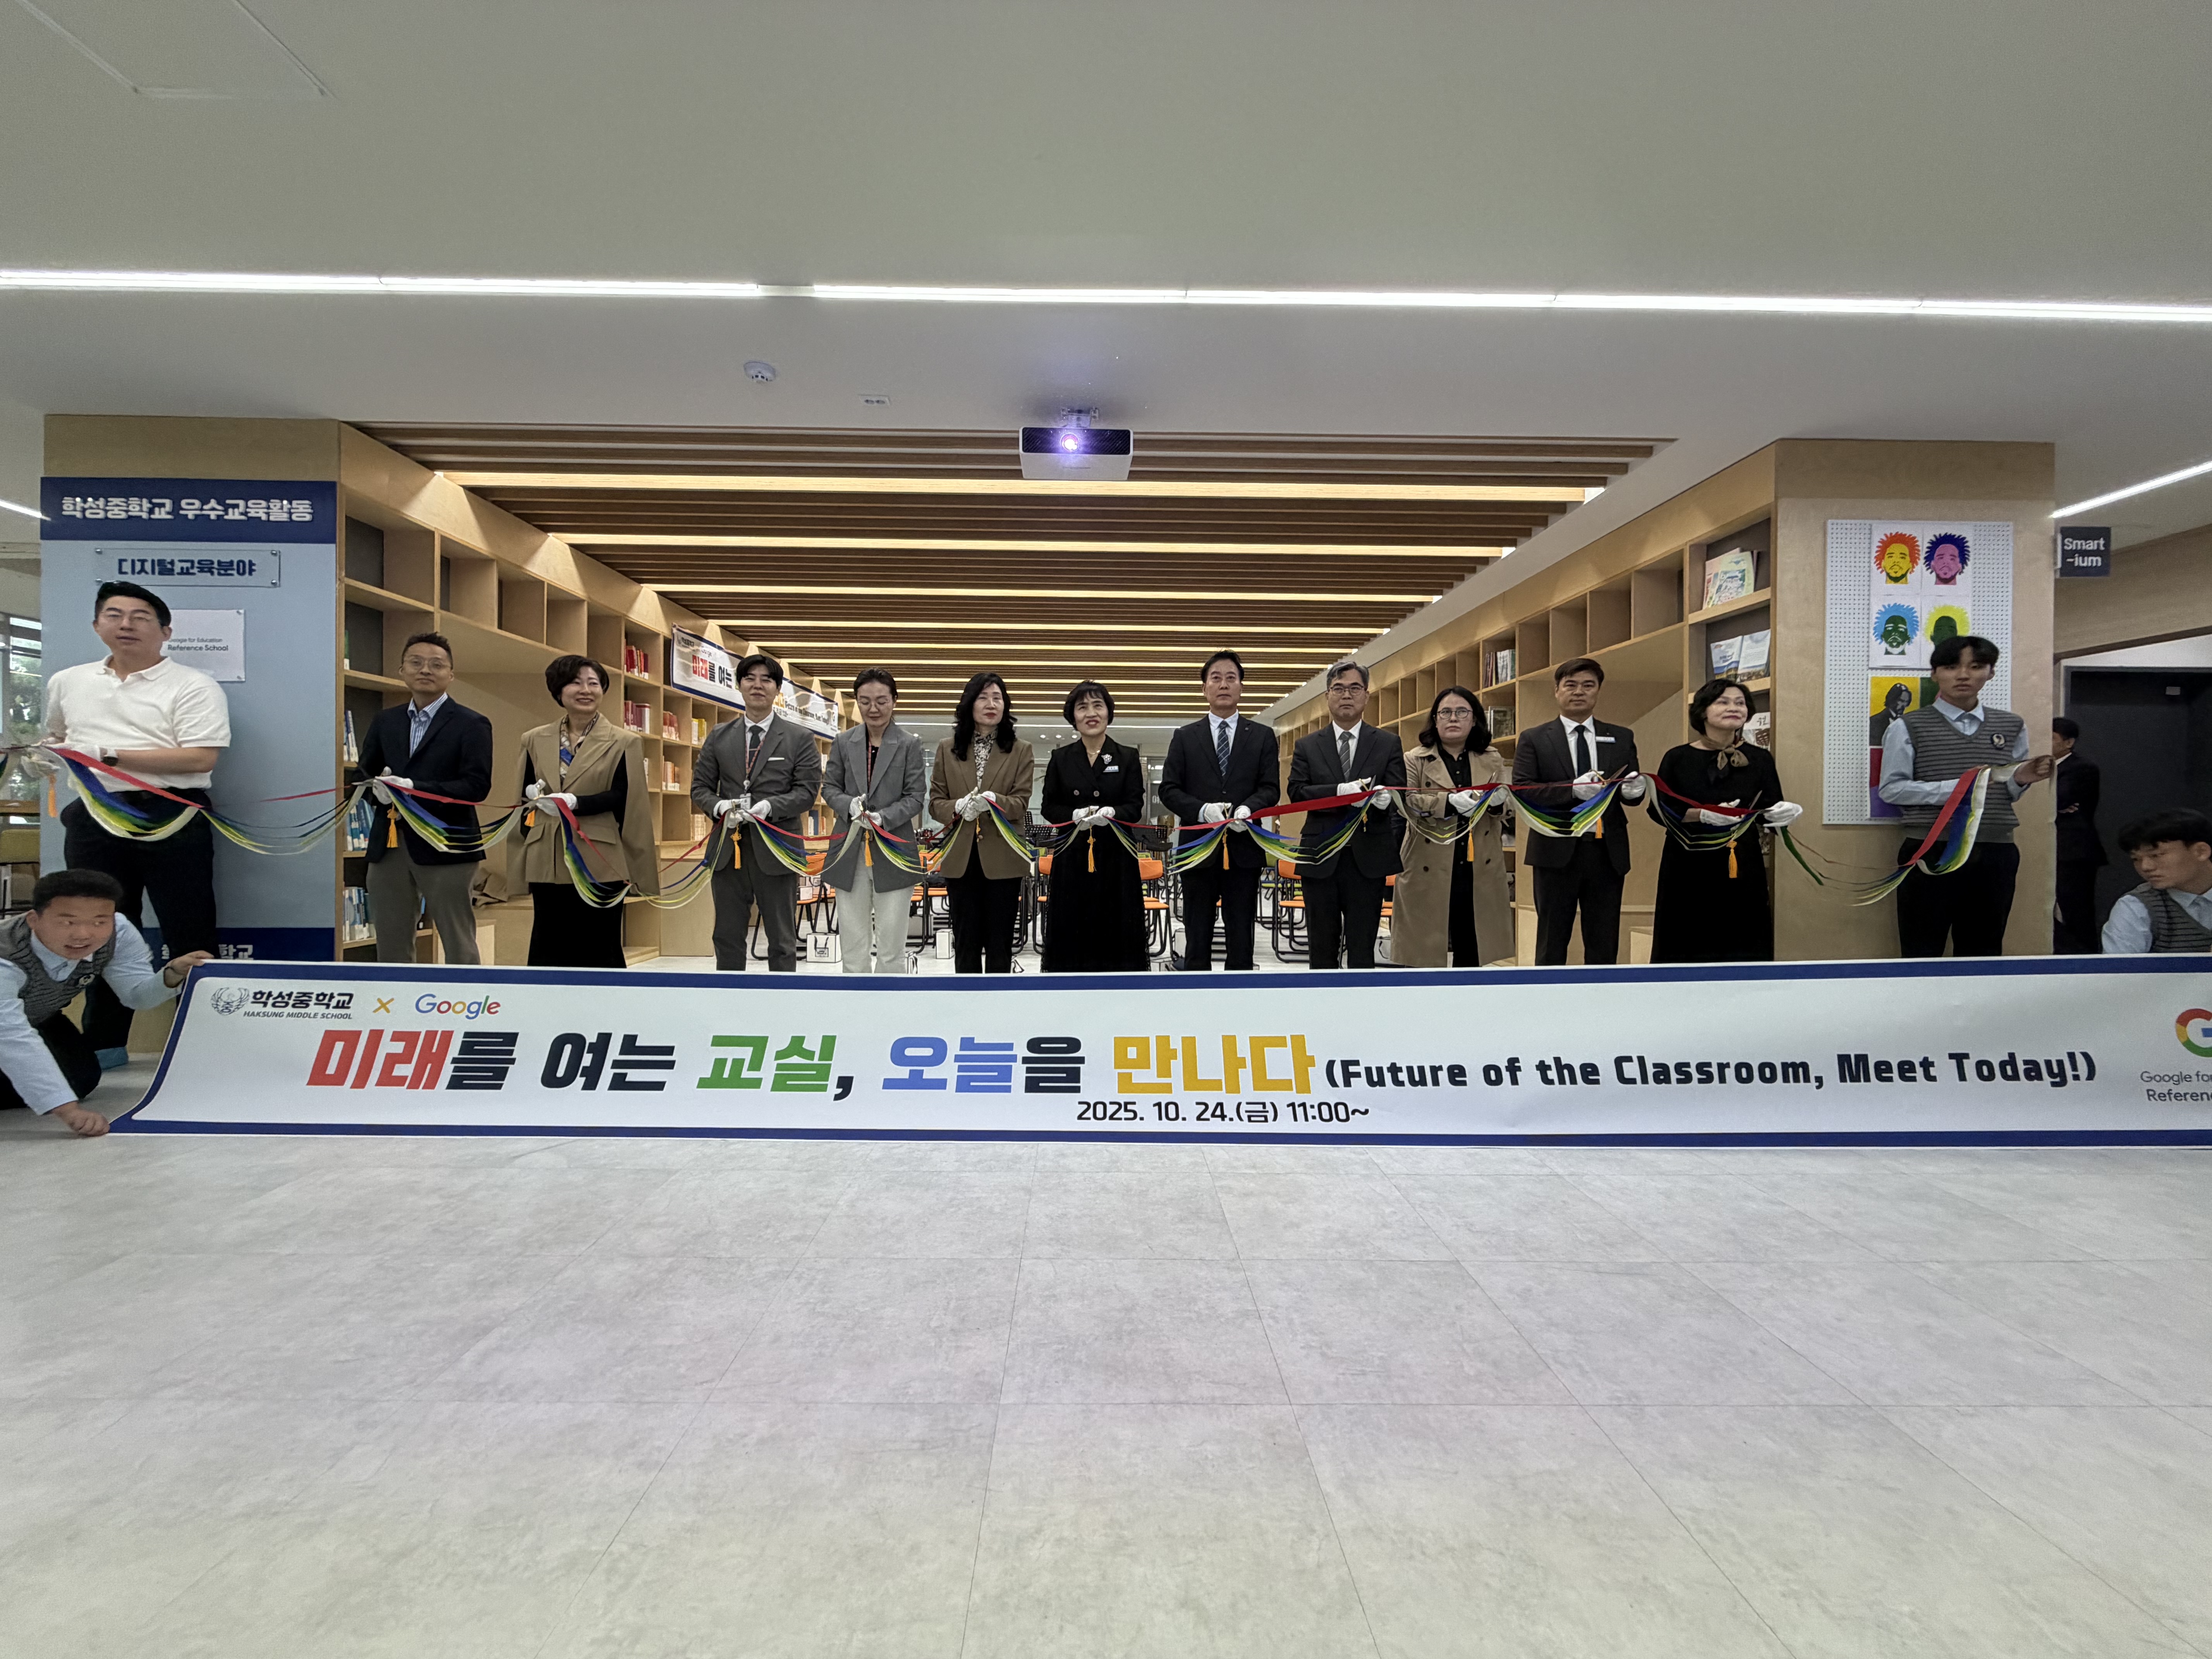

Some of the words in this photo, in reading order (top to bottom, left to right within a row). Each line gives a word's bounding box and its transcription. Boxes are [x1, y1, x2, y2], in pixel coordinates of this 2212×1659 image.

[62, 497, 174, 519] 학성중학교
[179, 498, 313, 522] 우수교육활동
[2064, 538, 2105, 550] Smart
[118, 558, 256, 576] 디지털교육분야
[2066, 554, 2102, 567] -ium
[692, 654, 715, 683] 미래를
[718, 666, 732, 689] 여는
[251, 990, 354, 1009] 학성중학교
[415, 994, 501, 1020] Google
[306, 1029, 519, 1090] 미래를
[541, 1032, 676, 1091] 여는
[696, 1035, 854, 1101] 교실,
[882, 1037, 1085, 1093] 오늘을
[1113, 1034, 1316, 1094] 만나다
[1325, 1059, 1468, 1088] (Future
[1482, 1057, 1522, 1086] of
[1535, 1056, 1601, 1085] the
[1613, 1056, 1824, 1090] Classroom,
[1837, 1054, 1937, 1083] Meet
[1948, 1051, 2096, 1087] Today!)
[2140, 1071, 2192, 1085] Google
[2146, 1089, 2212, 1102] Referen
[1077, 1101, 1144, 1121] 2025.
[1152, 1101, 1187, 1121] 10.
[1195, 1101, 1279, 1123] 24.(금)
[1286, 1102, 1369, 1122] 11:00~
